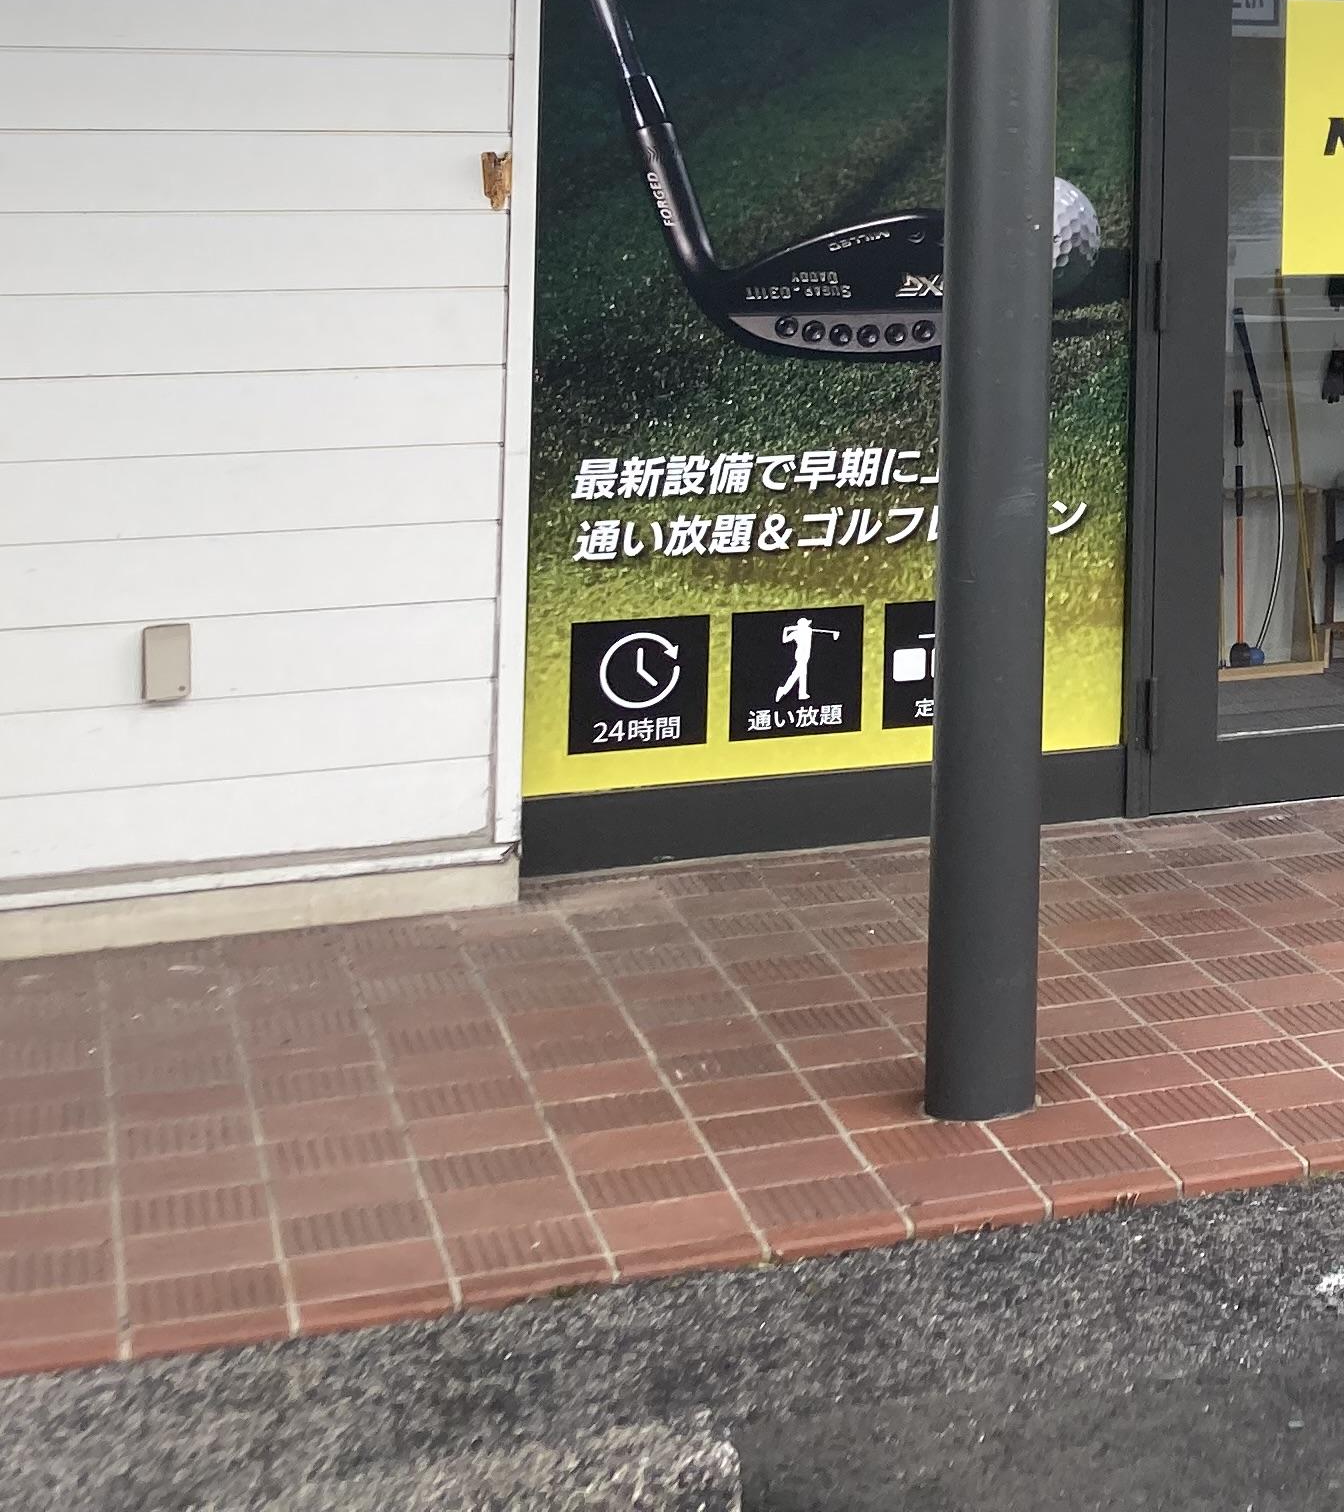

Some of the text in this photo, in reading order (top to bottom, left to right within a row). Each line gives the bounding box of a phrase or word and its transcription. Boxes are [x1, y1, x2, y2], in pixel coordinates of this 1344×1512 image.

[646, 172, 676, 227] FORGED
[592, 716, 681, 745] 24時間
[747, 703, 843, 733] 通い放題
